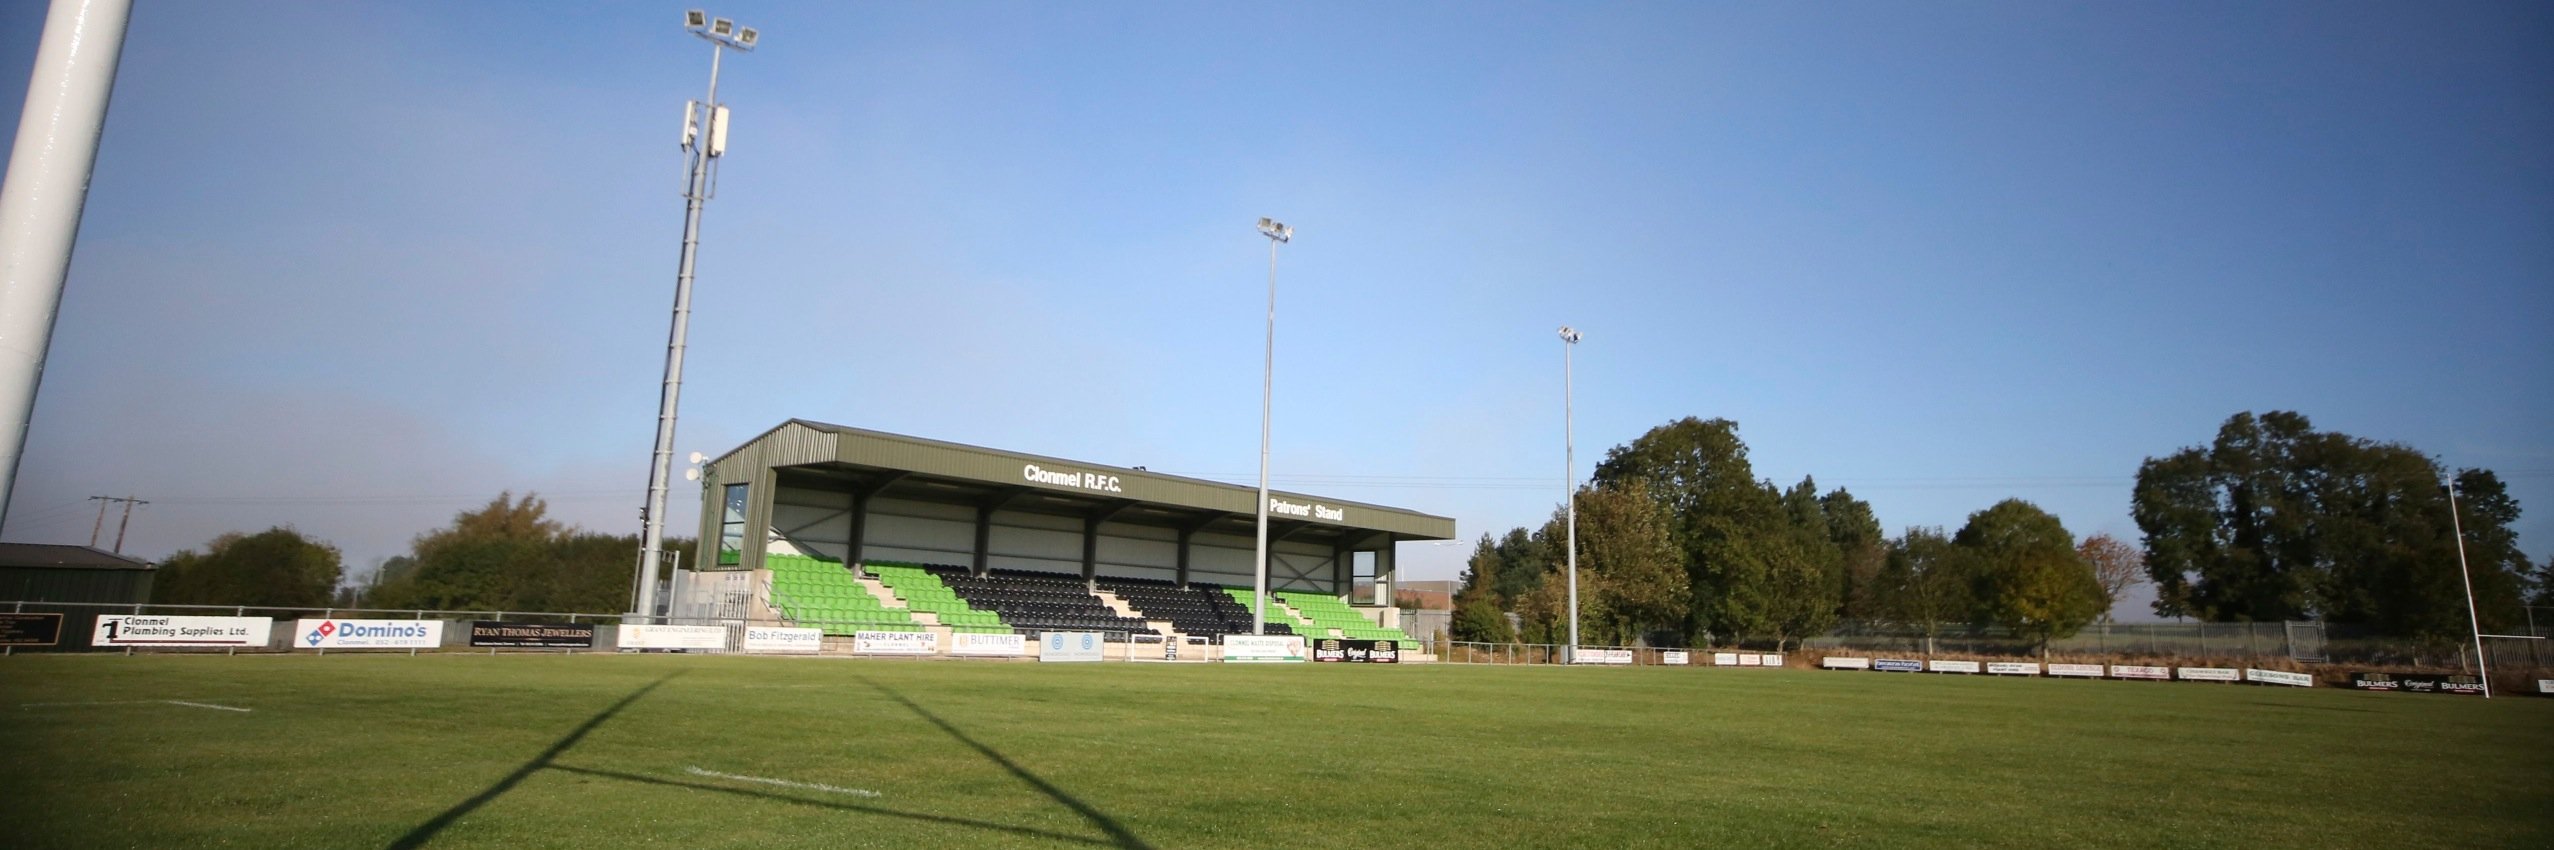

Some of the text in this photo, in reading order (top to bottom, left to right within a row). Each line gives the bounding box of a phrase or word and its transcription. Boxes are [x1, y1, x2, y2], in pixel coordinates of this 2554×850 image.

[1024, 464, 1122, 492] Clonmel R.F.C.
[1270, 498, 1343, 521] Patrons' Stand
[124, 617, 169, 626] Clonmel
[122, 626, 249, 637] Plumbing Supplies Ltd.
[338, 622, 427, 637] Domino's
[473, 627, 592, 638] RYAN THOMAS JEWELLERS
[749, 630, 768, 640] Bob
[771, 631, 816, 642] Fitzgerald
[857, 632, 886, 640] MAHER
[888, 633, 914, 641] PLANT
[970, 634, 1020, 645] BUTTIMER
[1316, 649, 1345, 659] BULMERS
[1369, 650, 1396, 659] BULMERS
[2356, 679, 2399, 688] BULMERS
[2441, 682, 2485, 691] BULMERS
